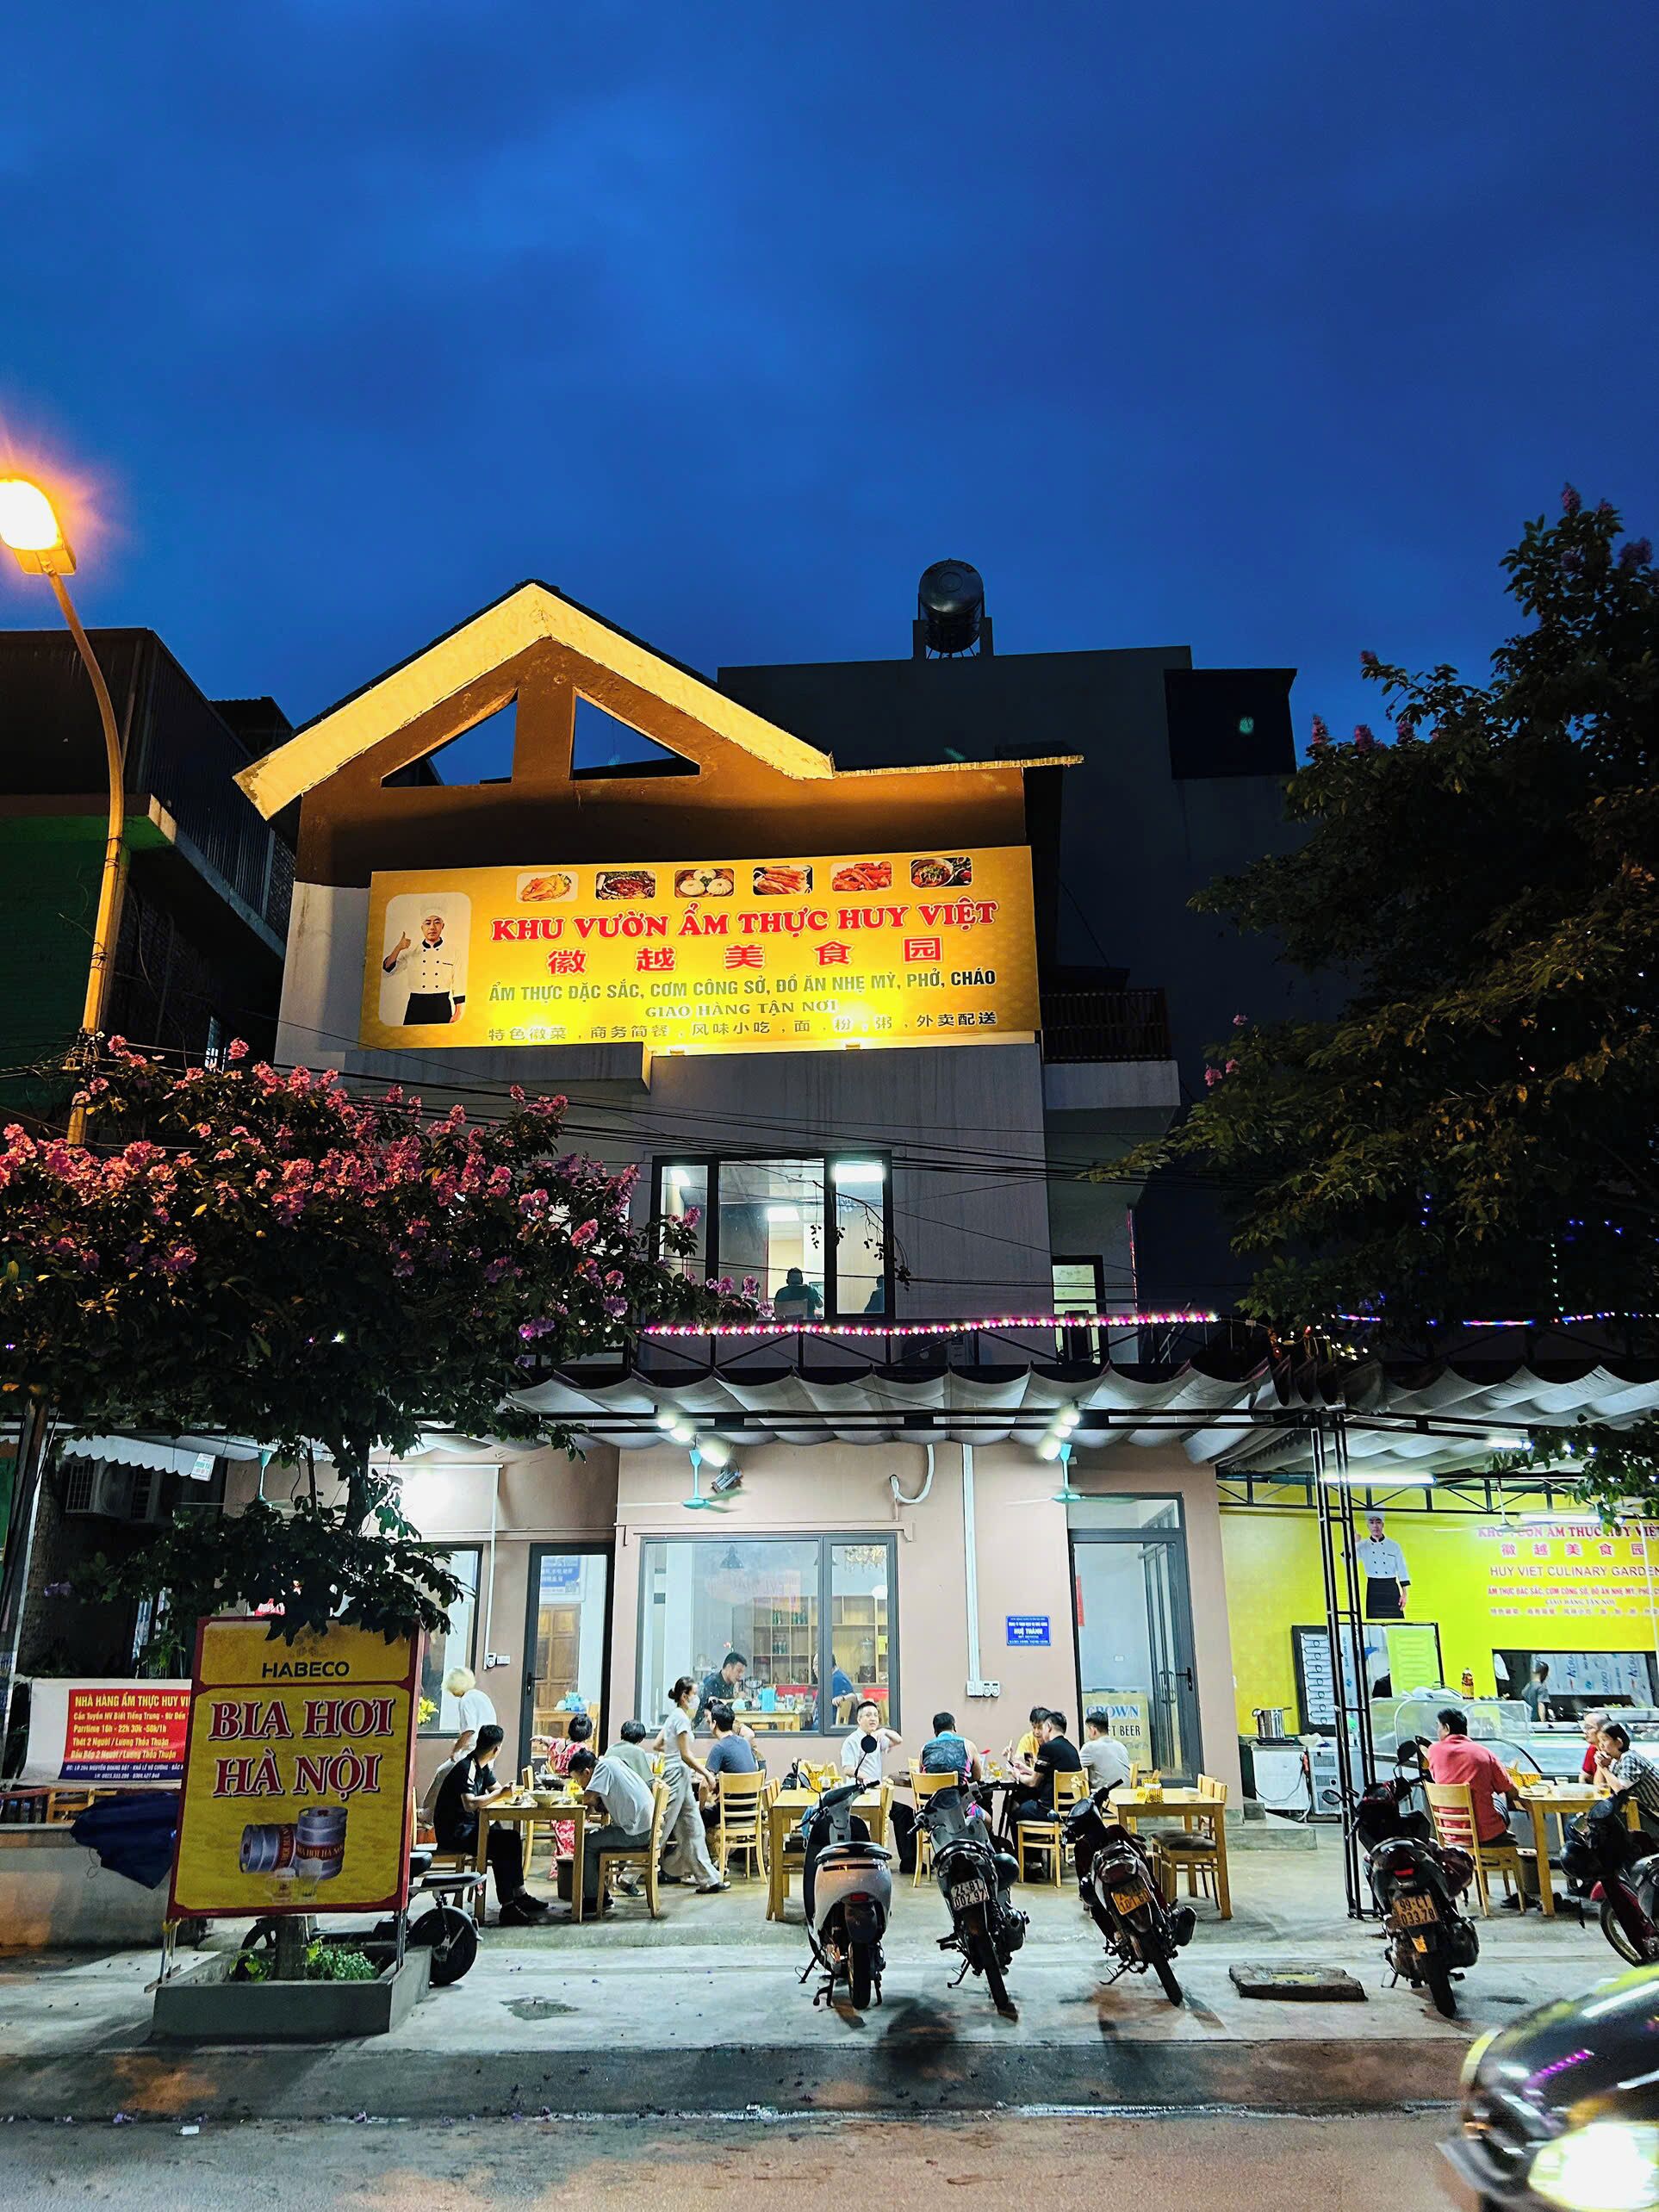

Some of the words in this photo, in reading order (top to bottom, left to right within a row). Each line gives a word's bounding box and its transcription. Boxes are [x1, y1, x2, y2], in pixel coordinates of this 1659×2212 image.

[491, 917, 564, 941] KHU
[574, 910, 669, 938] VƯỜN
[678, 903, 729, 936] ẨM
[737, 906, 829, 938] THỰC
[837, 905, 910, 929] HUY
[917, 897, 998, 930] VIỆT
[488, 981, 516, 1001] ẨM
[520, 985, 562, 1003] THỰC
[568, 983, 601, 1002] ĐẶC
[606, 979, 645, 999] SẮC,
[650, 982, 687, 997] CƠM
[693, 979, 738, 996] CÔNG
[743, 975, 771, 996] SỞ,
[775, 973, 798, 992] ĐỒ
[804, 974, 827, 991] ĂN
[832, 976, 866, 992] NHẸ
[871, 972, 902, 990] MỲ,
[907, 968, 946, 988] PHỞ,
[951, 967, 997, 985] CHÁO
[645, 1004, 691, 1017] GIAO
[699, 1001, 751, 1016] HÀNG
[758, 1000, 795, 1016] TẬN
[802, 999, 837, 1013] NƠI
[1490, 1567, 1514, 1576] HUY
[1518, 1567, 1544, 1576] VIET
[1547, 1566, 1607, 1577] CULINARY
[261, 1661, 351, 1678] HABECO
[75, 1693, 94, 1707] NHÀ
[96, 1693, 120, 1707] HÀNG
[138, 1694, 159, 1710] THỰC
[162, 1695, 179, 1707] HUY
[208, 1699, 294, 1740] BIA
[301, 1698, 396, 1737] HƠI
[1120, 1725, 1141, 1737] BEER
[213, 1746, 285, 1798] HÀ
[292, 1746, 383, 1802] NỘI
